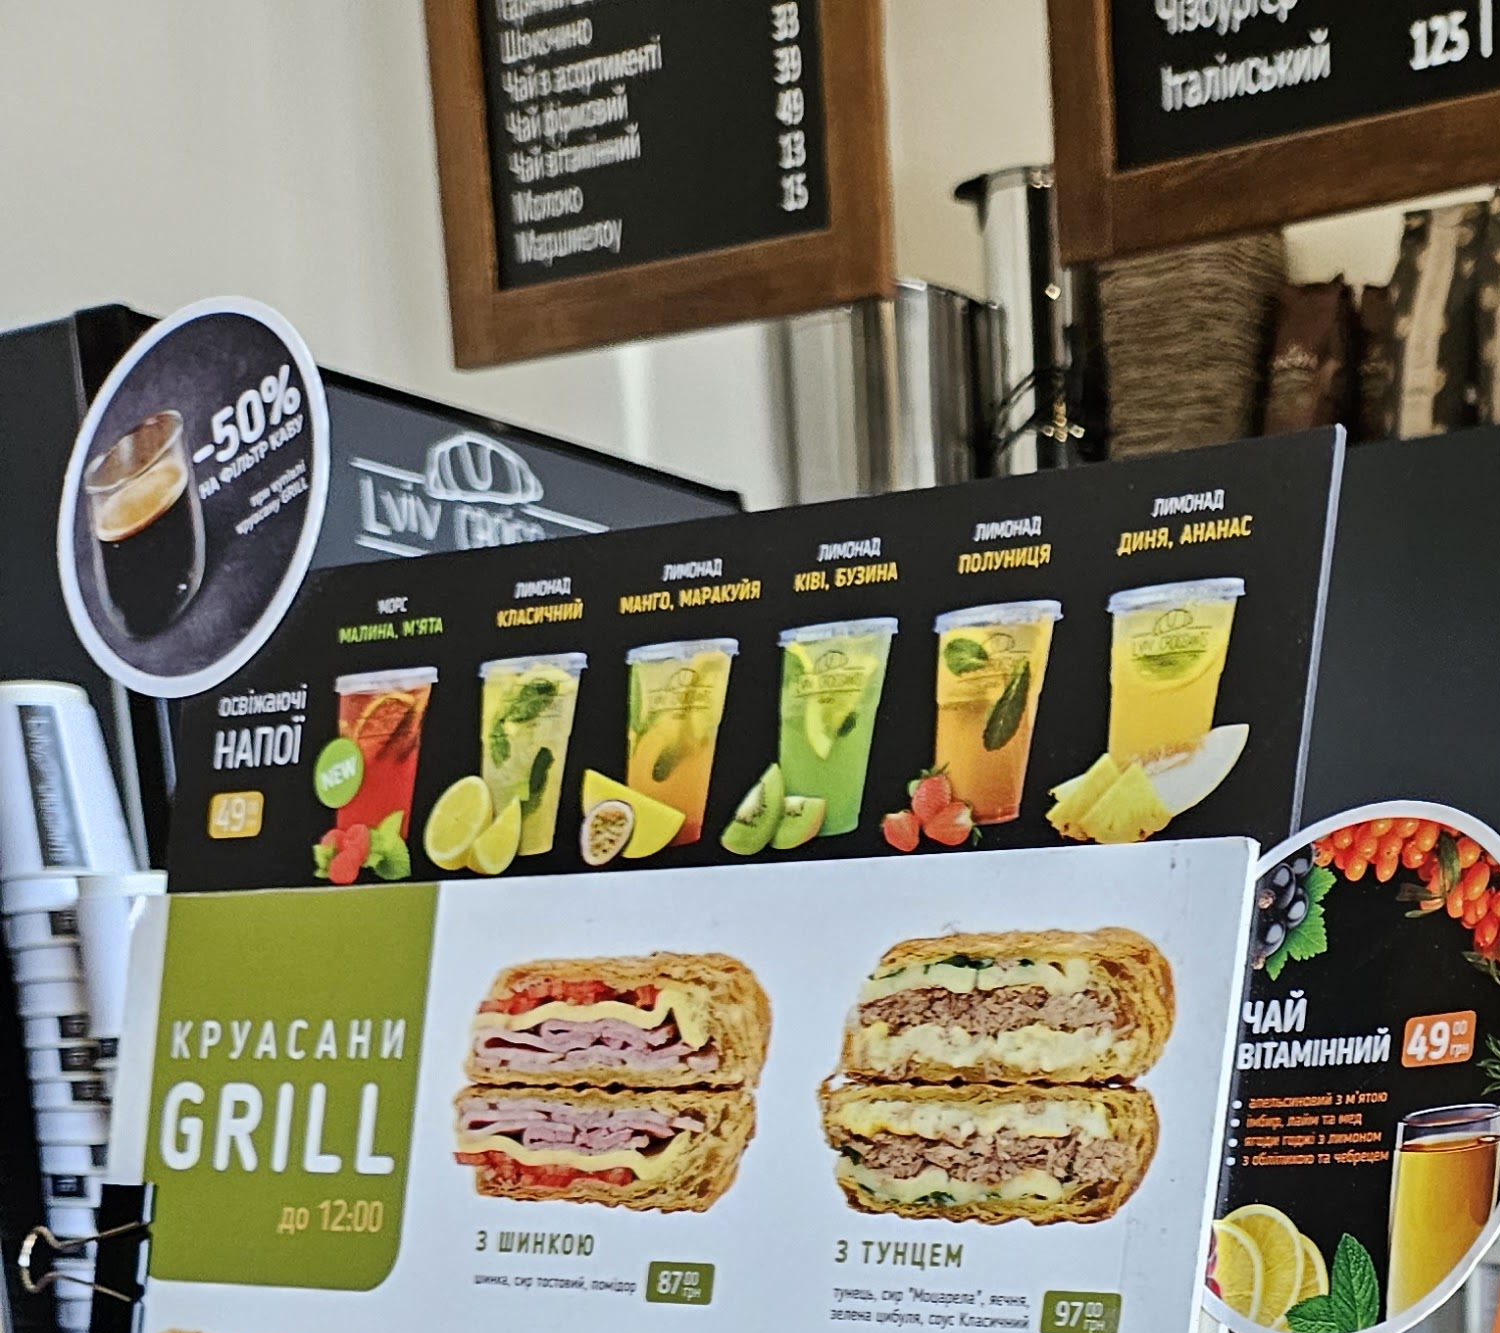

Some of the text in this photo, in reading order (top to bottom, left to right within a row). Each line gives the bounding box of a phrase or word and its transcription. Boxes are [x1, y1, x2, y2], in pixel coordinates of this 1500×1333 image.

[1409, 9, 1470, 71] 125
[502, 63, 539, 102] Чай
[773, 44, 803, 85] 39
[505, 104, 541, 143] Чай
[775, 87, 806, 126] 49
[508, 145, 544, 183] Чай
[778, 129, 807, 170] 13
[511, 185, 584, 225] Молоко
[780, 172, 810, 213] 15
[193, 364, 302, 463] -50%
[199, 477, 221, 500] НА
[1151, 489, 1225, 518] ЛИМОНАД
[973, 516, 1042, 542] ЛИМОНАД
[1115, 515, 1253, 557] ДИНЯ, АНАНАС
[817, 537, 881, 562] ЛИМОНАД
[957, 543, 1051, 575] ПОЛУНИЦЯ
[513, 577, 572, 599] ЛИМОНАД
[662, 558, 723, 582] ЛИМОНАД
[793, 562, 898, 592] КІВІ, БУЗИНА
[496, 597, 584, 628] КЛАСИЧНИЙ
[619, 578, 761, 615] МАНГО, МАРАКУЙЯ
[402, 617, 443, 638] М'ЯТА
[212, 715, 306, 771] НАПОЇ
[319, 756, 357, 791] NEW
[213, 796, 247, 833] 49
[1242, 989, 1307, 1035] ЧАЙ
[170, 1018, 407, 1060] КРУАСАНИ
[1236, 1027, 1391, 1071] ВІТАМІННИЙ
[1406, 1021, 1450, 1061] 49
[160, 1081, 395, 1175] GRILL
[276, 1199, 384, 1235] до 12:00
[474, 1230, 595, 1257] З ШИНКОЮ
[834, 1239, 964, 1271] З ТУНЦЕМ
[656, 1270, 681, 1296] 87
[682, 1271, 699, 1286] 00
[1054, 1301, 1083, 1327] 97
[1084, 1302, 1104, 1317] 00
